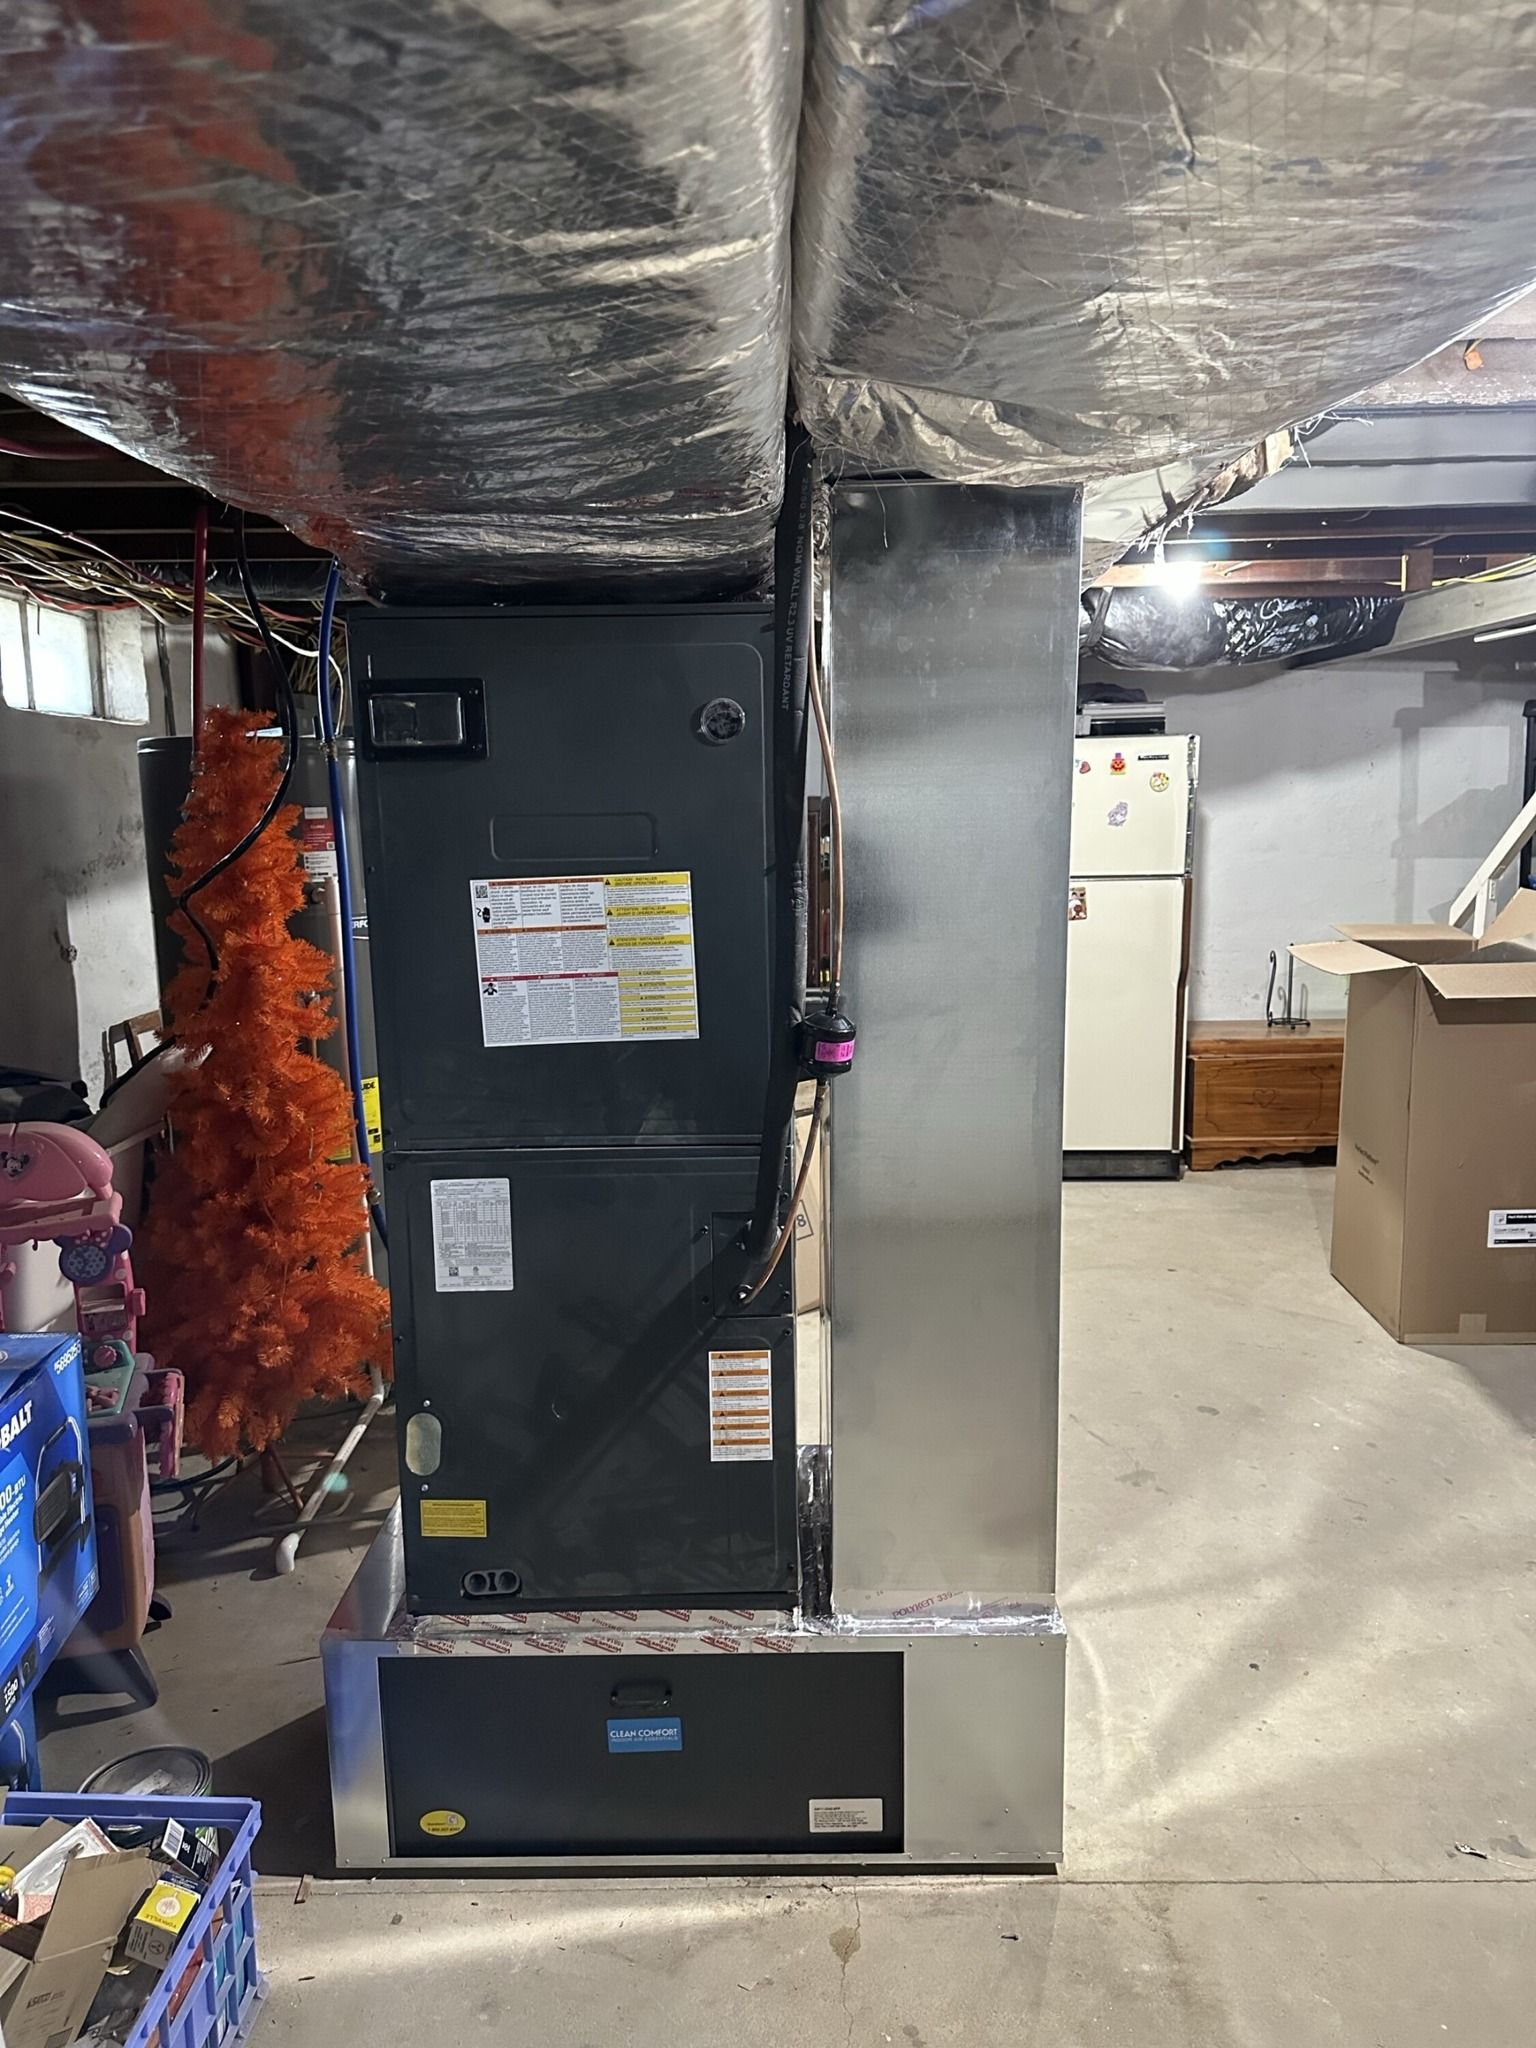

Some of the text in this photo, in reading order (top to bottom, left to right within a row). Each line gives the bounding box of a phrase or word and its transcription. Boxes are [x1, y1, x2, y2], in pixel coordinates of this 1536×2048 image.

[794, 536, 804, 564] NOM
[789, 566, 801, 601] WALL
[785, 627, 795, 644] UV
[780, 645, 793, 710] RETARDANT
[0, 1400, 33, 1449] BALT
[609, 1728, 678, 1738] CLEAN COMFORT
